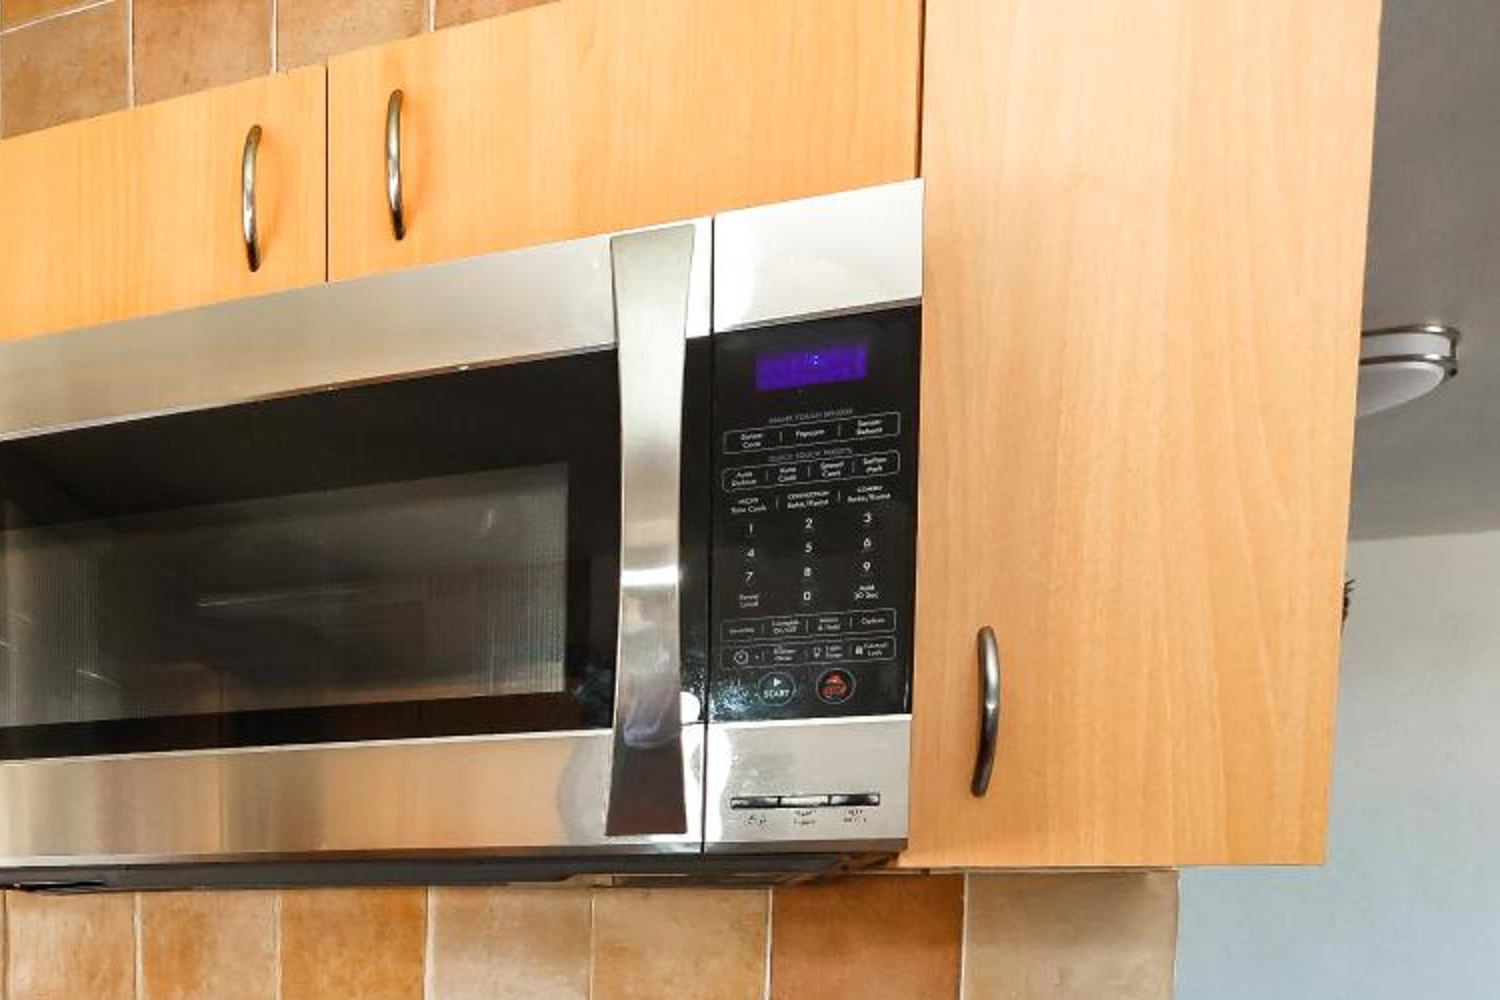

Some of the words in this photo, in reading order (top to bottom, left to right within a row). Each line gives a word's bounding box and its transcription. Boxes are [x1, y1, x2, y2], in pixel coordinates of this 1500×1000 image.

[805, 518, 814, 530] 2
[863, 513, 873, 524] 3
[805, 542, 813, 554] 5
[863, 537, 872, 548] 6
[747, 548, 755, 558] 4
[863, 561, 872, 572] 9
[746, 570, 754, 582] 7
[803, 567, 812, 578] 8
[803, 590, 812, 602] 0
[763, 689, 790, 699] START
